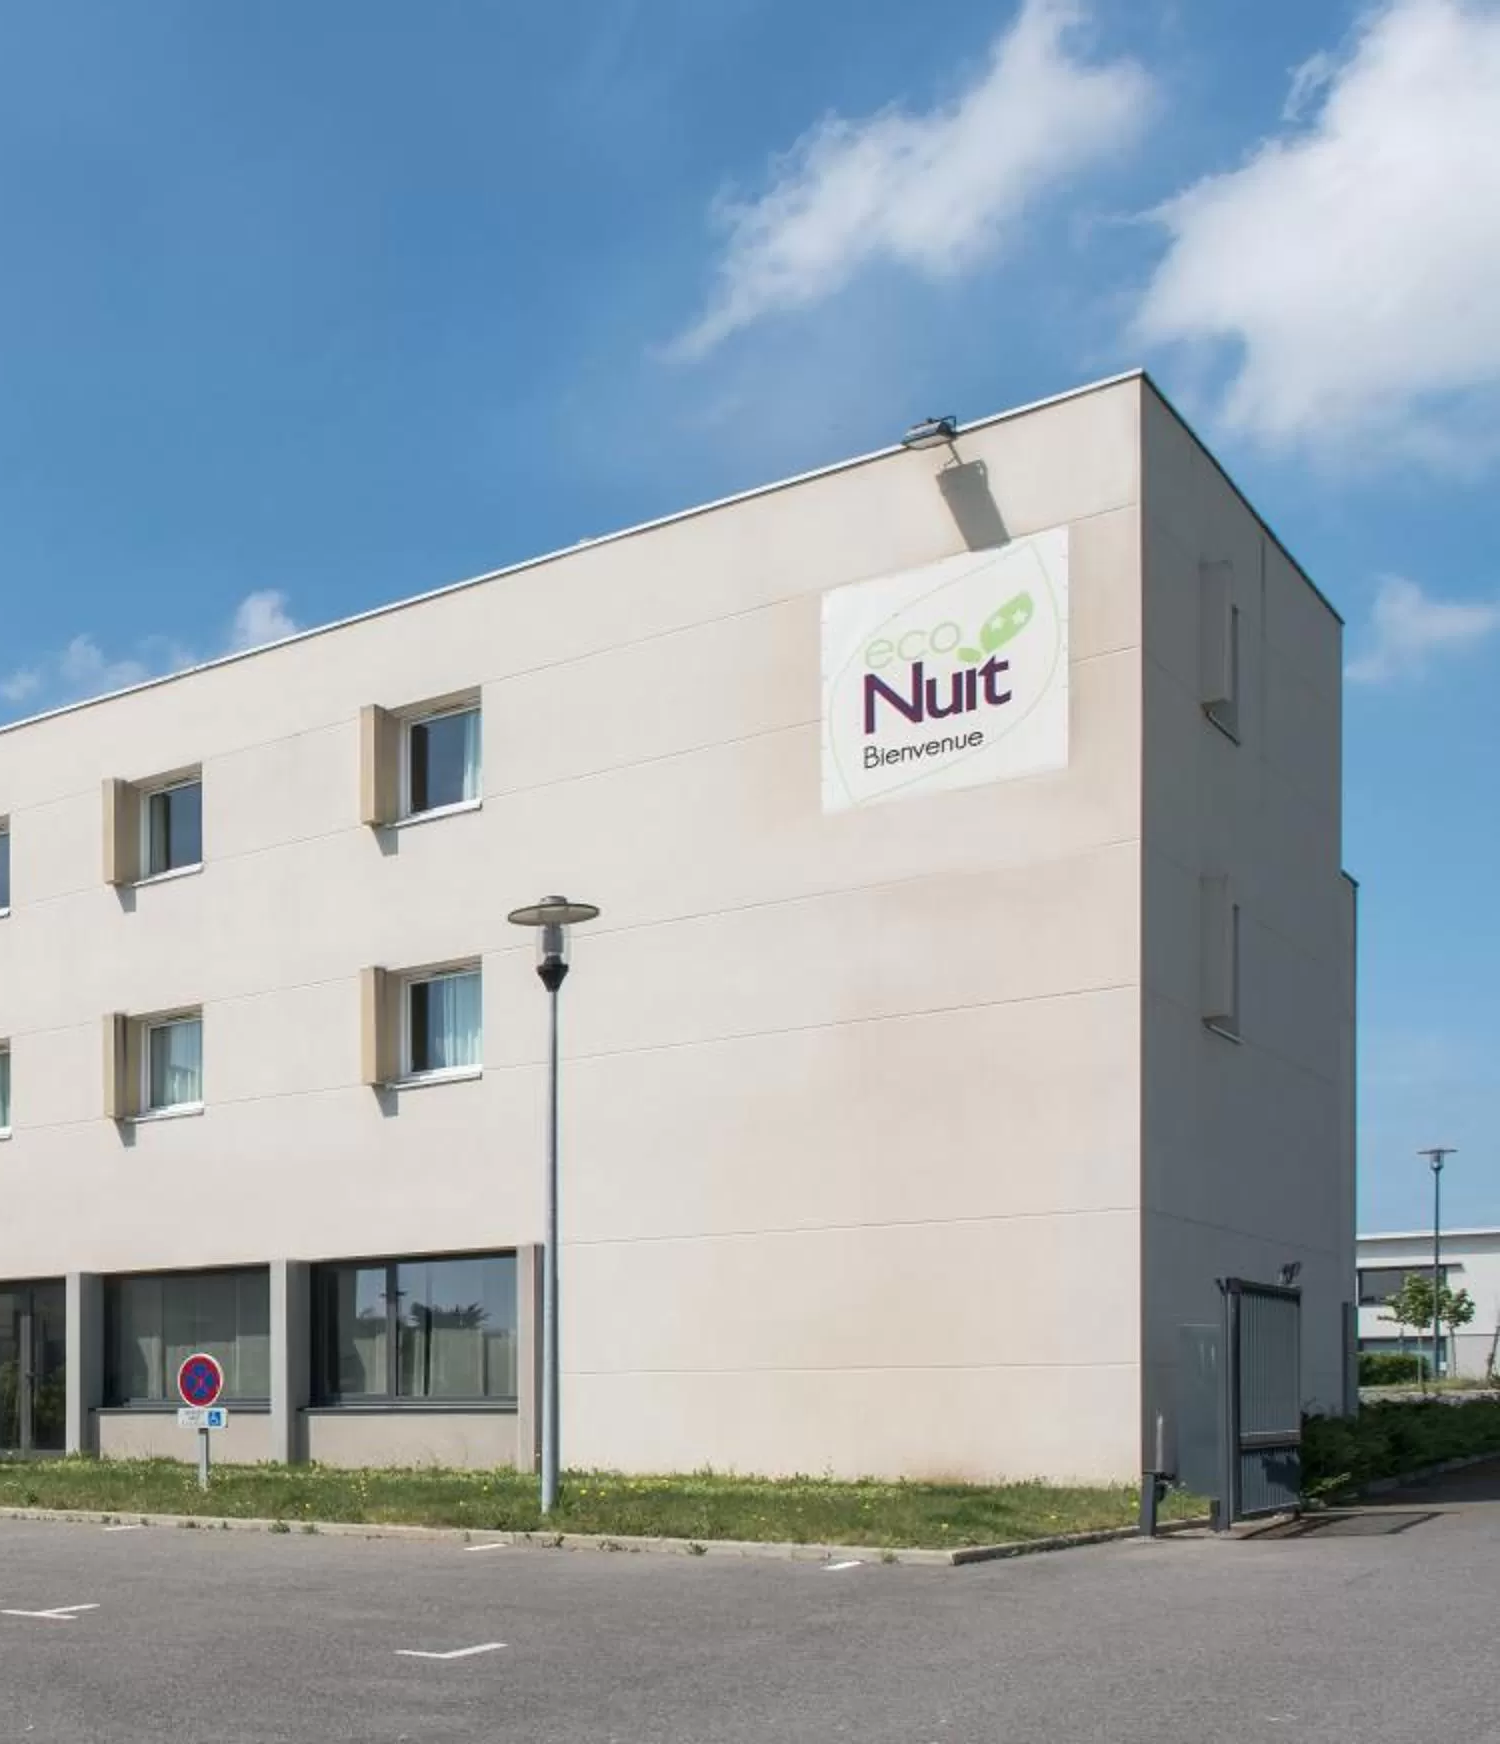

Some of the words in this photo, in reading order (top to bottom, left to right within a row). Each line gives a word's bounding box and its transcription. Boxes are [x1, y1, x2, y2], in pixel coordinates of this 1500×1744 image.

[865, 621, 961, 669] eco
[864, 655, 1012, 735] Nuit
[863, 731, 984, 769] Bienvenue
